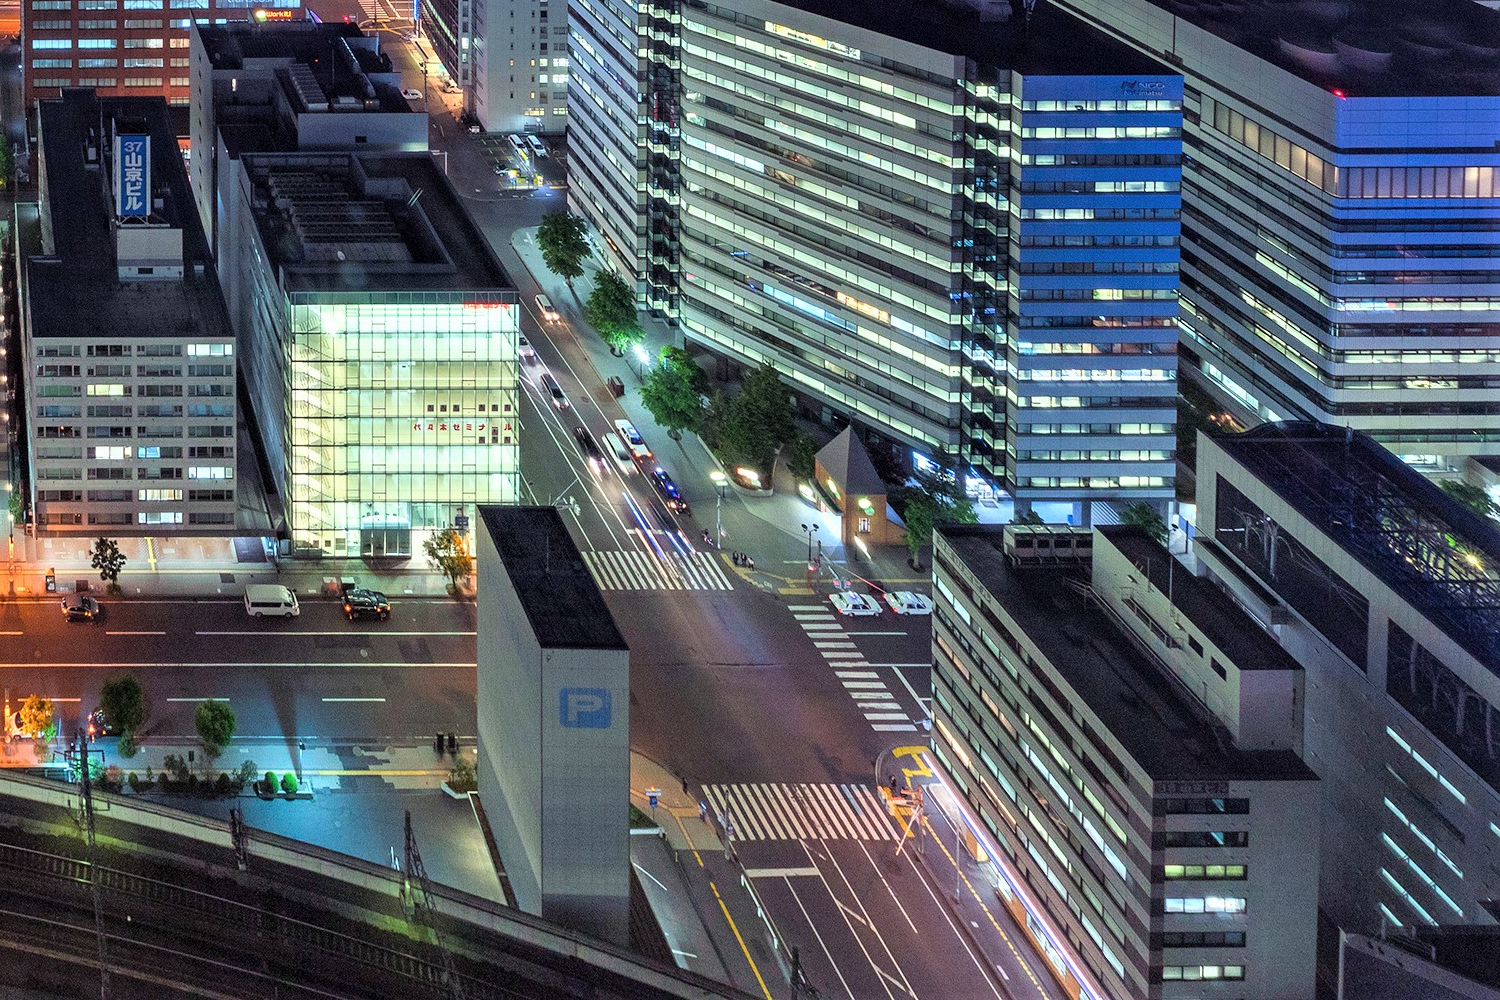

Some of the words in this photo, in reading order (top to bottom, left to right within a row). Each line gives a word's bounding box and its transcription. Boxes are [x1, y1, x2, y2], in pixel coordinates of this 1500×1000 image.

[413, 423, 513, 432] 代々木ゼミナール
[567, 694, 602, 721] P
